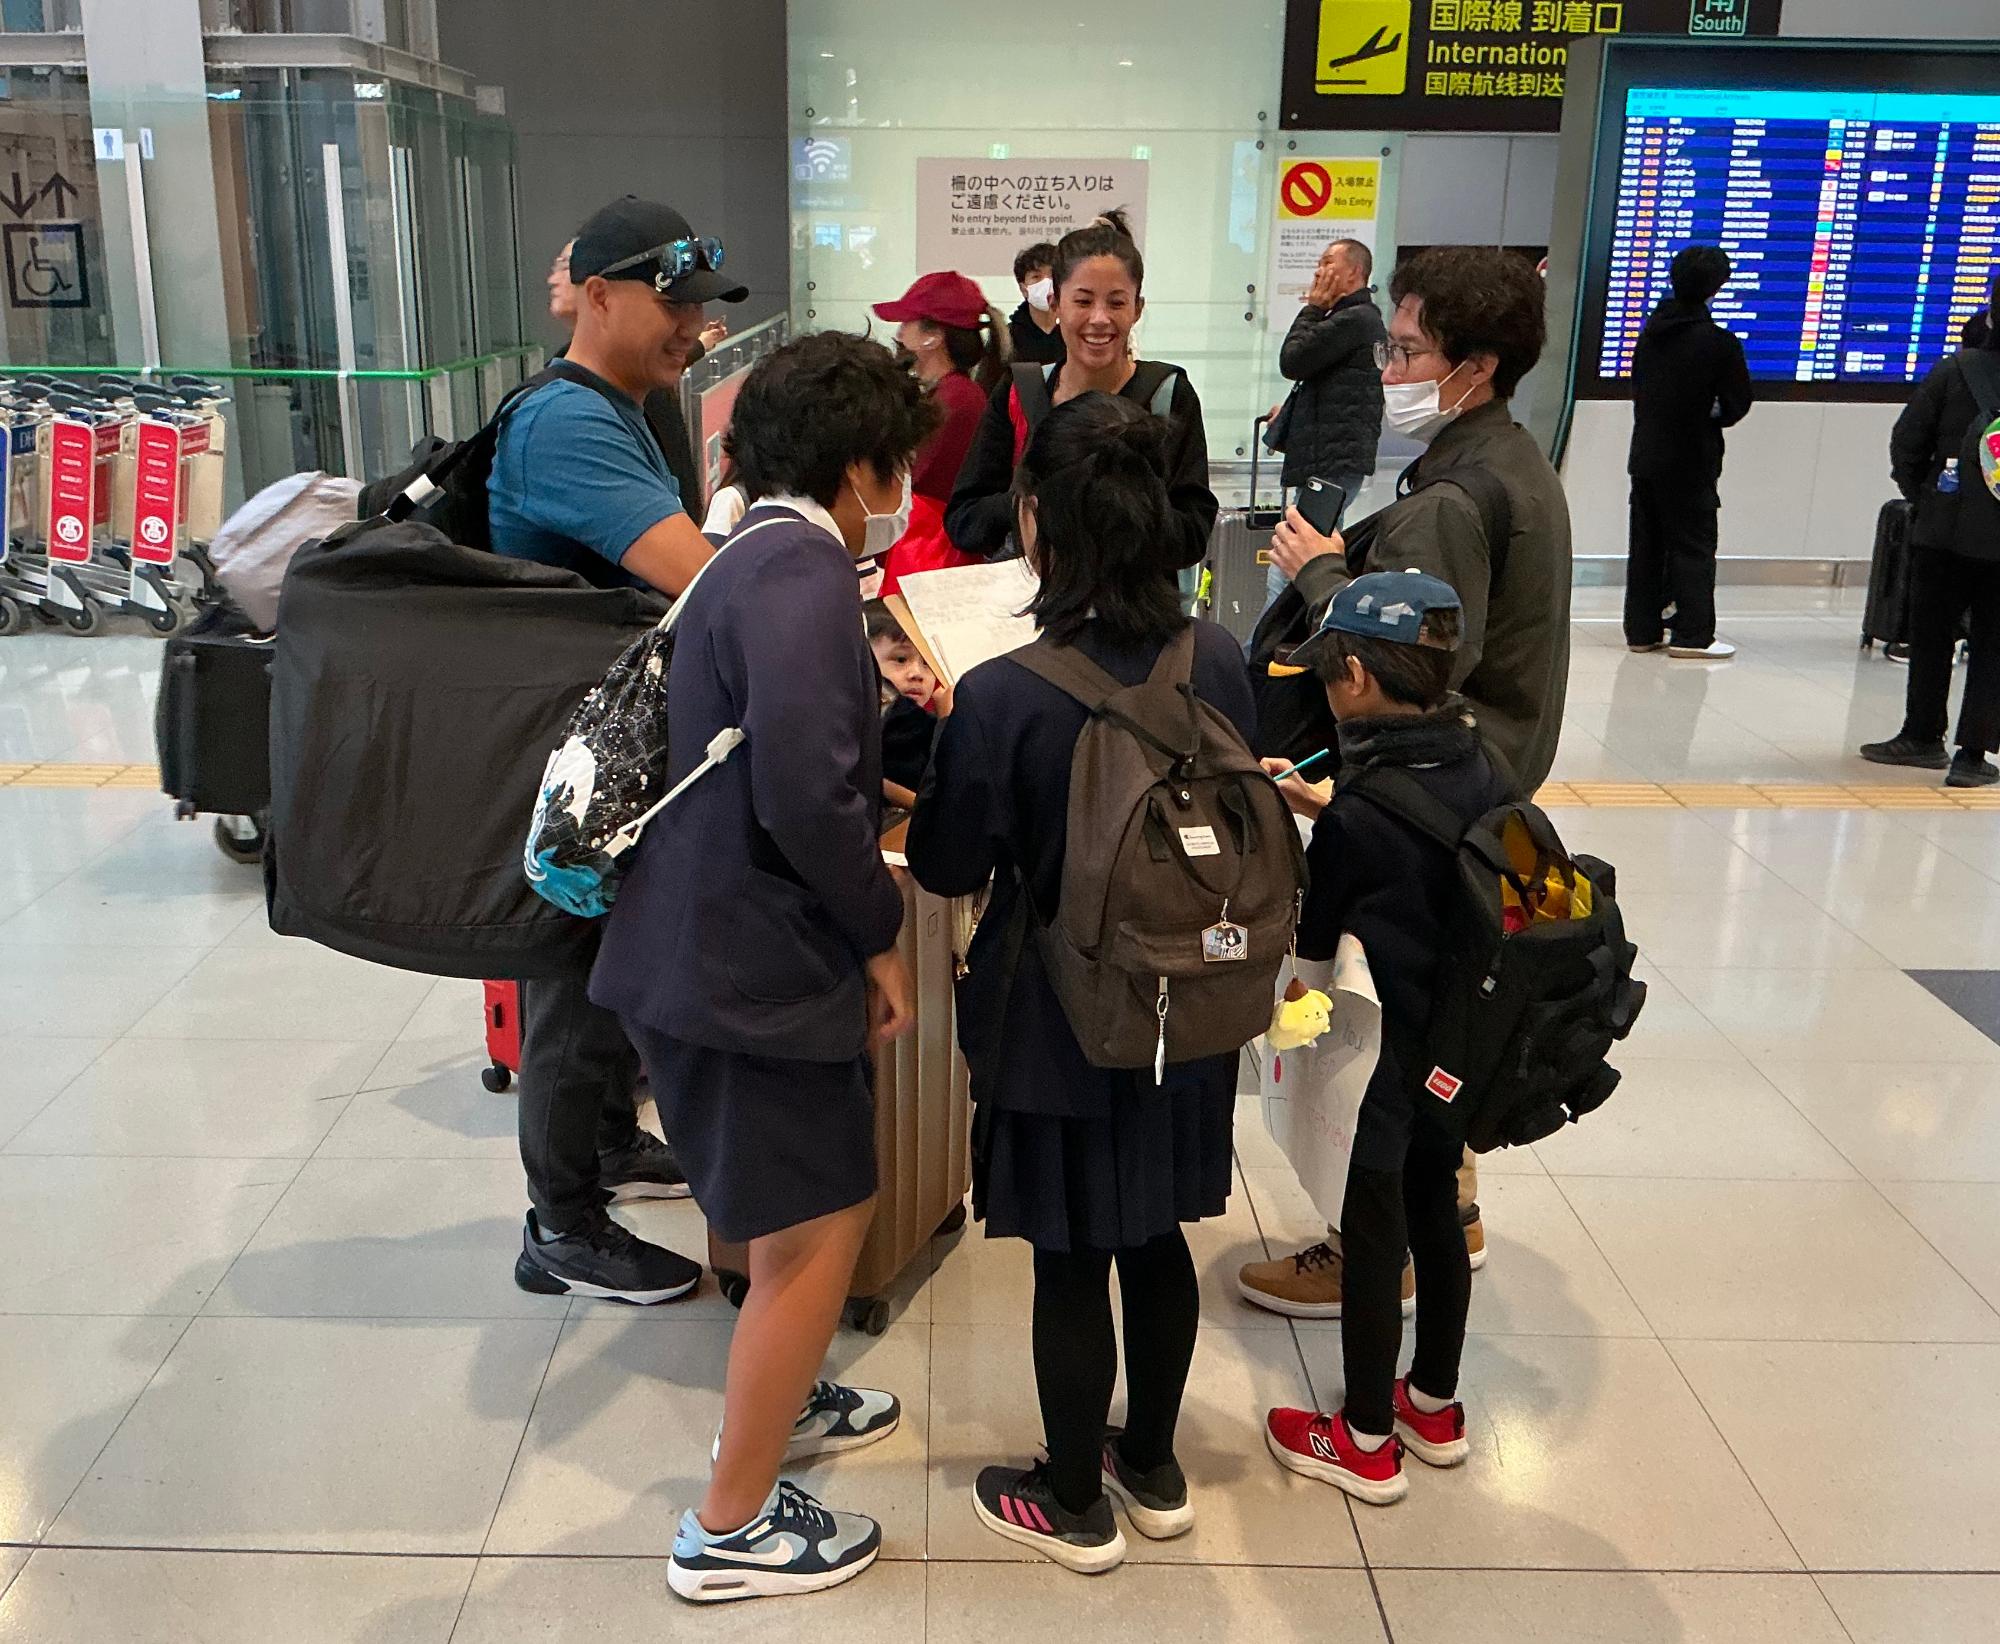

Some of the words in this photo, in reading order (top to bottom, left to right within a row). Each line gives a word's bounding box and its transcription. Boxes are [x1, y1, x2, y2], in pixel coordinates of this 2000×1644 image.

[1429, 0, 1523, 32] 国際線
[1530, 1, 1623, 33] 到着口
[1693, 14, 1741, 31] South
[951, 175, 1115, 192] 柵の中への立ち入りは
[1334, 176, 1374, 187] 入場禁止
[951, 193, 1071, 210] ご遠慮ください。
[1334, 197, 1347, 206] No
[1349, 197, 1374, 208] Entry
[951, 214, 964, 223] No
[966, 214, 991, 225] entry
[993, 214, 1027, 225] beyond
[1028, 214, 1047, 223] this
[1048, 214, 1076, 225] point.
